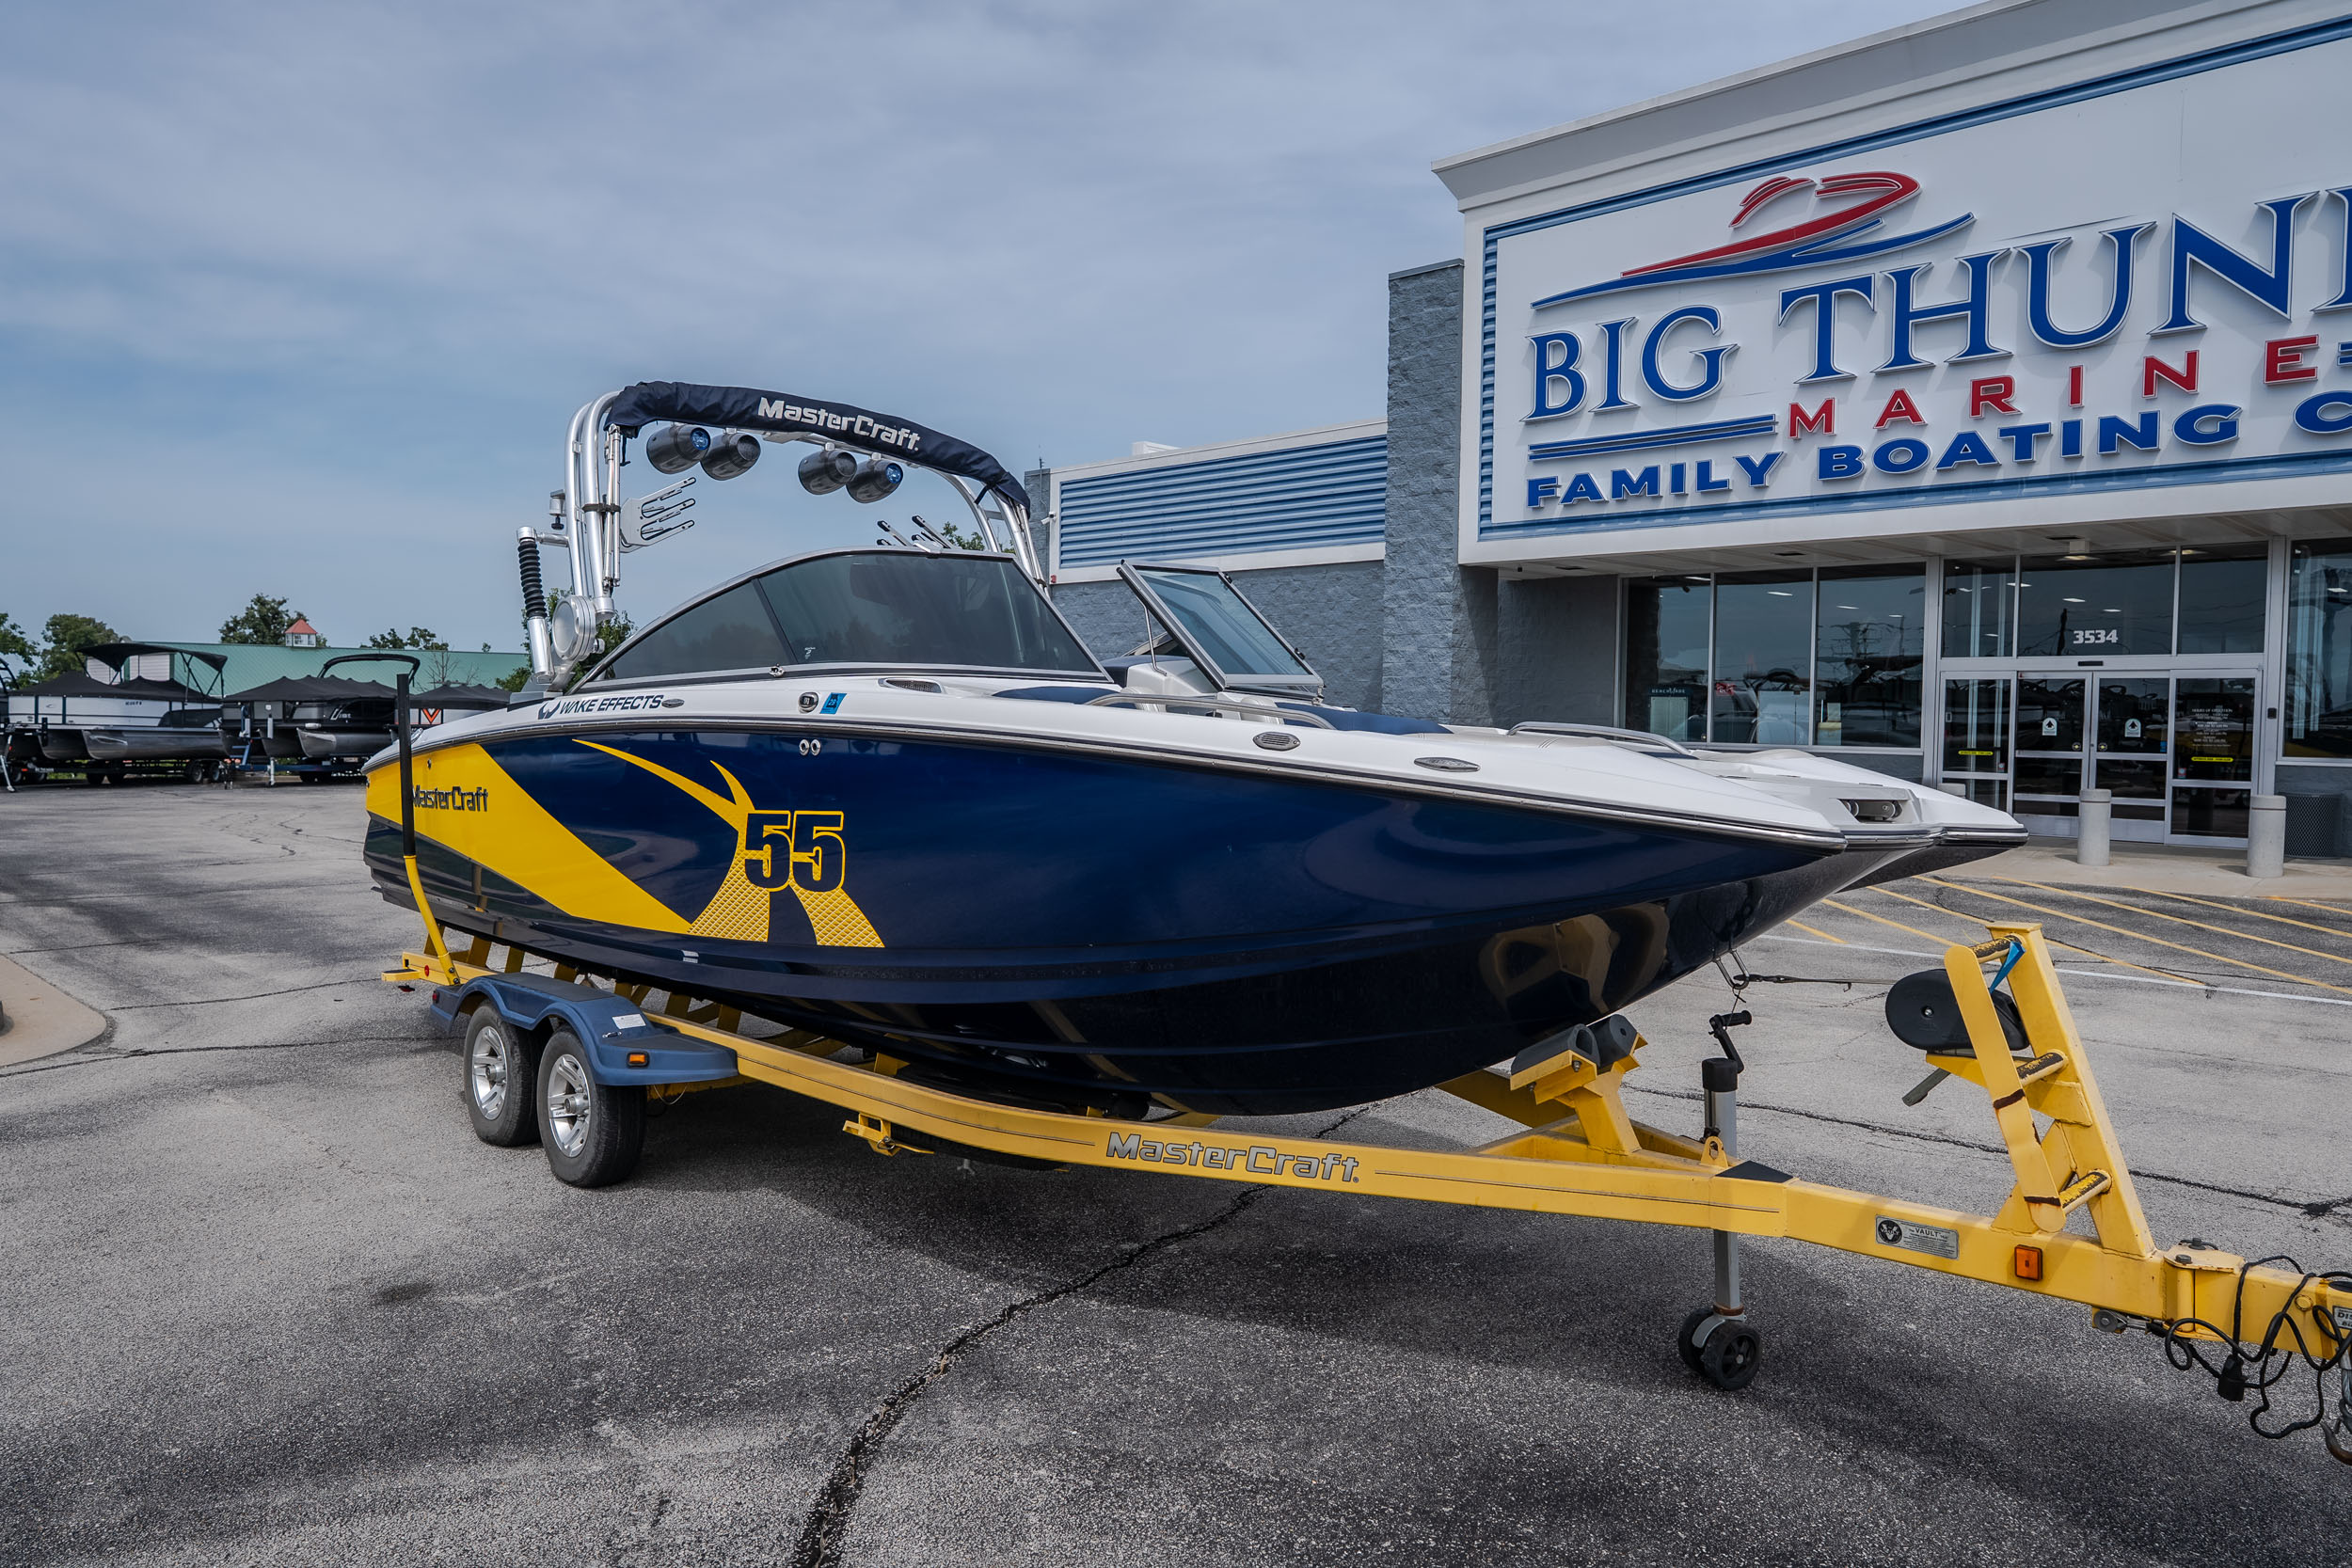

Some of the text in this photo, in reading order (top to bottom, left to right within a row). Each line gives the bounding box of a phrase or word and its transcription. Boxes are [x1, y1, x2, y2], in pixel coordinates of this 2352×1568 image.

[1518, 304, 1740, 422] BIG
[1788, 334, 2320, 439] MARINE
[757, 396, 920, 451] MasterCraft
[1527, 451, 1786, 508] FAMILY
[1816, 404, 2243, 482] BOATING
[2073, 629, 2119, 644] 3534
[559, 694, 664, 715] WAKE EFFECTS
[743, 810, 846, 893] 55
[1105, 1132, 1359, 1182] MasterCraft
[1915, 1227, 1940, 1238] VAULT
